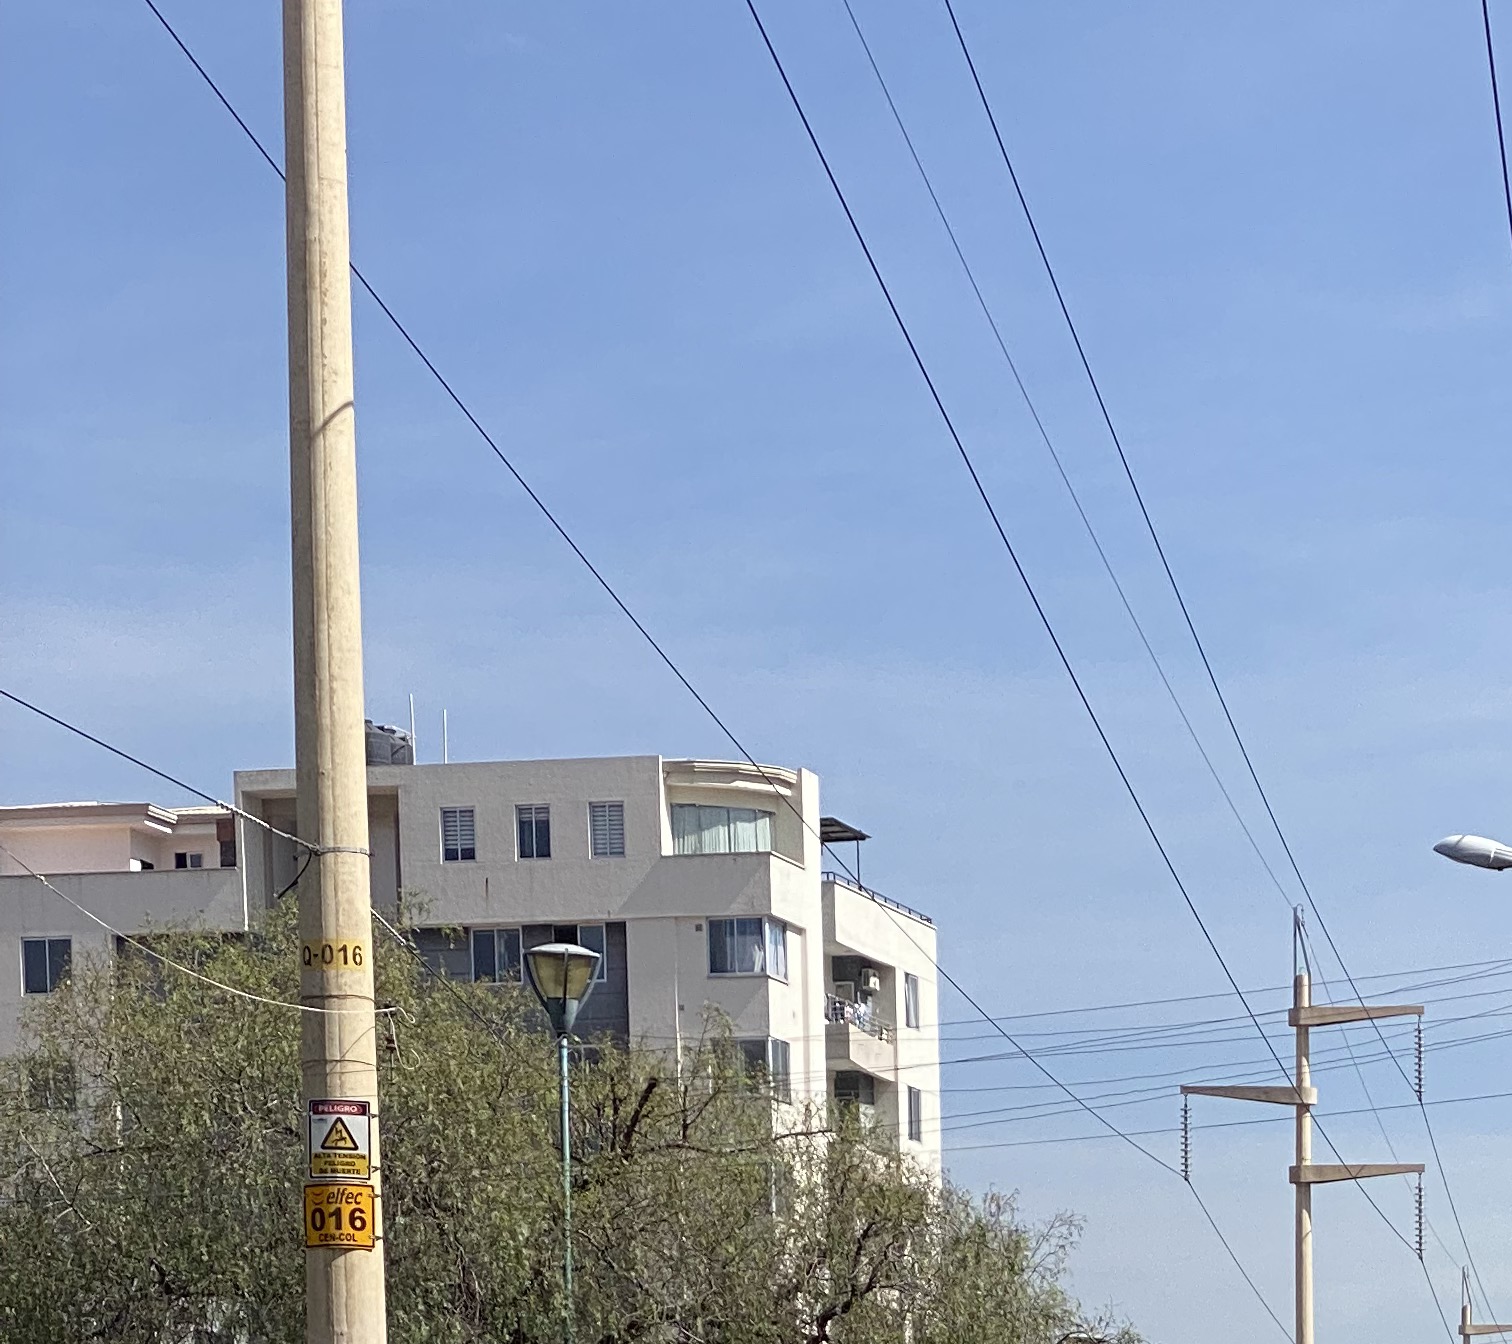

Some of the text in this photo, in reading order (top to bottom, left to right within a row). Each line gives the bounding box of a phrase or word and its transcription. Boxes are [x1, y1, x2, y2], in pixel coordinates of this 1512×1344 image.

[318, 1103, 359, 1113] PELIGRO
[326, 1187, 363, 1206] elfec
[310, 1206, 367, 1232] 016
[318, 1232, 358, 1243] CEN-COL
